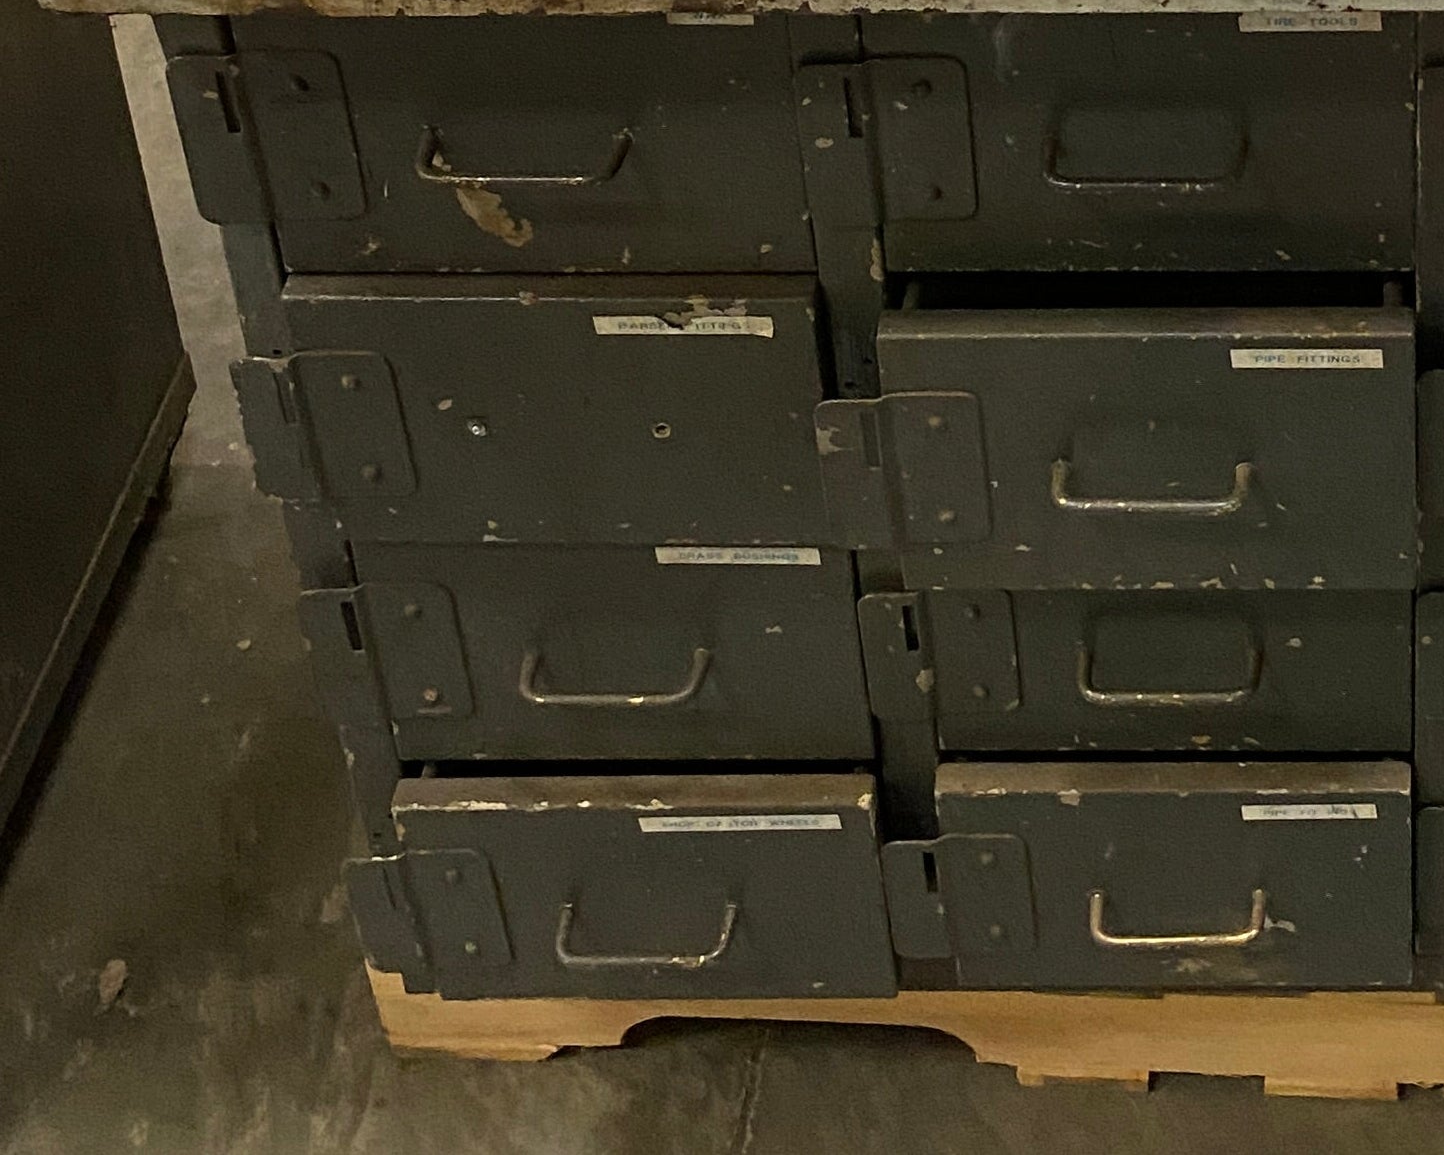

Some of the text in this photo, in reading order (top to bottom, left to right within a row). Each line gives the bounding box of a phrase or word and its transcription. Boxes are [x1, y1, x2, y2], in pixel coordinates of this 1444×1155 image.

[1309, 16, 1359, 27] TOOLS
[1253, 354, 1361, 364] PIPE FITTINGS
